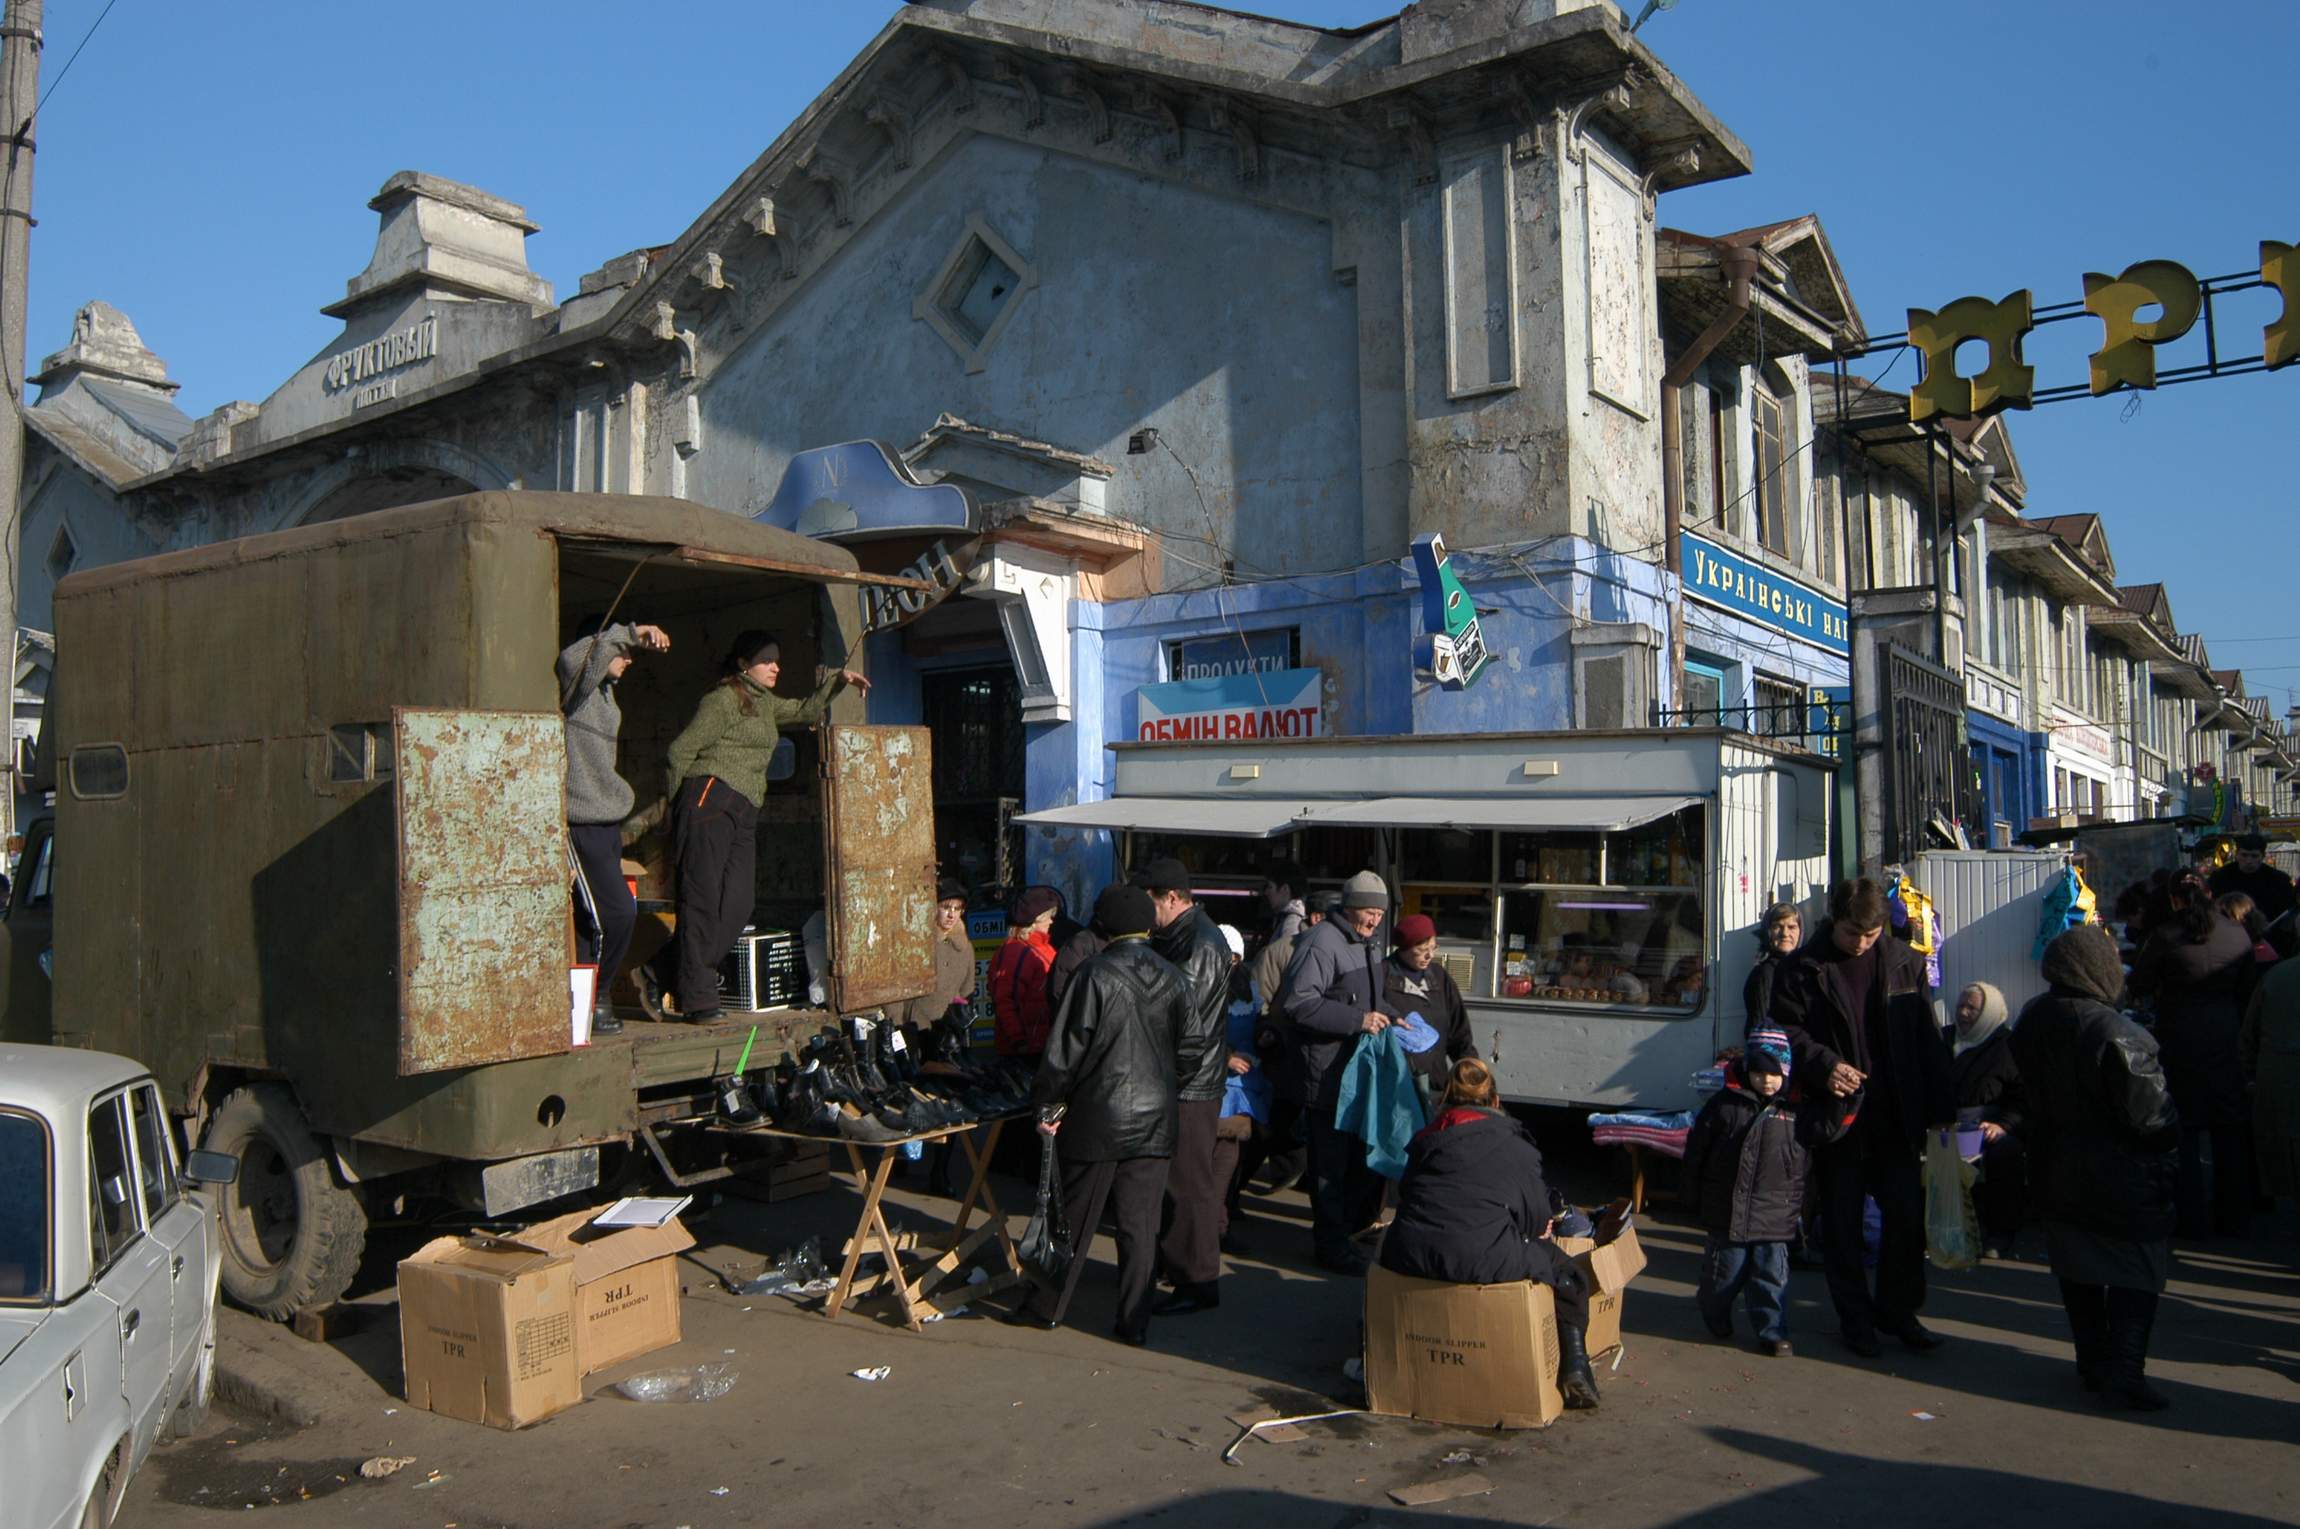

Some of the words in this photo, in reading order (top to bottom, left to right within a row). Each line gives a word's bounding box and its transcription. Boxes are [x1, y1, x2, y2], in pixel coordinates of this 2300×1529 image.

[328, 310, 437, 389] ФРУКТОВЫЙ
[1140, 714, 1218, 741] ОБМІН
[1224, 706, 1318, 740] ВАЛЮТ
[973, 920, 1008, 935] ОБМІ
[604, 1284, 633, 1303] TPR
[1598, 1296, 1615, 1313] TPR
[1405, 1332, 1441, 1345] INDOOR
[441, 1341, 465, 1358] TPR
[1426, 1348, 1465, 1366] TPR
